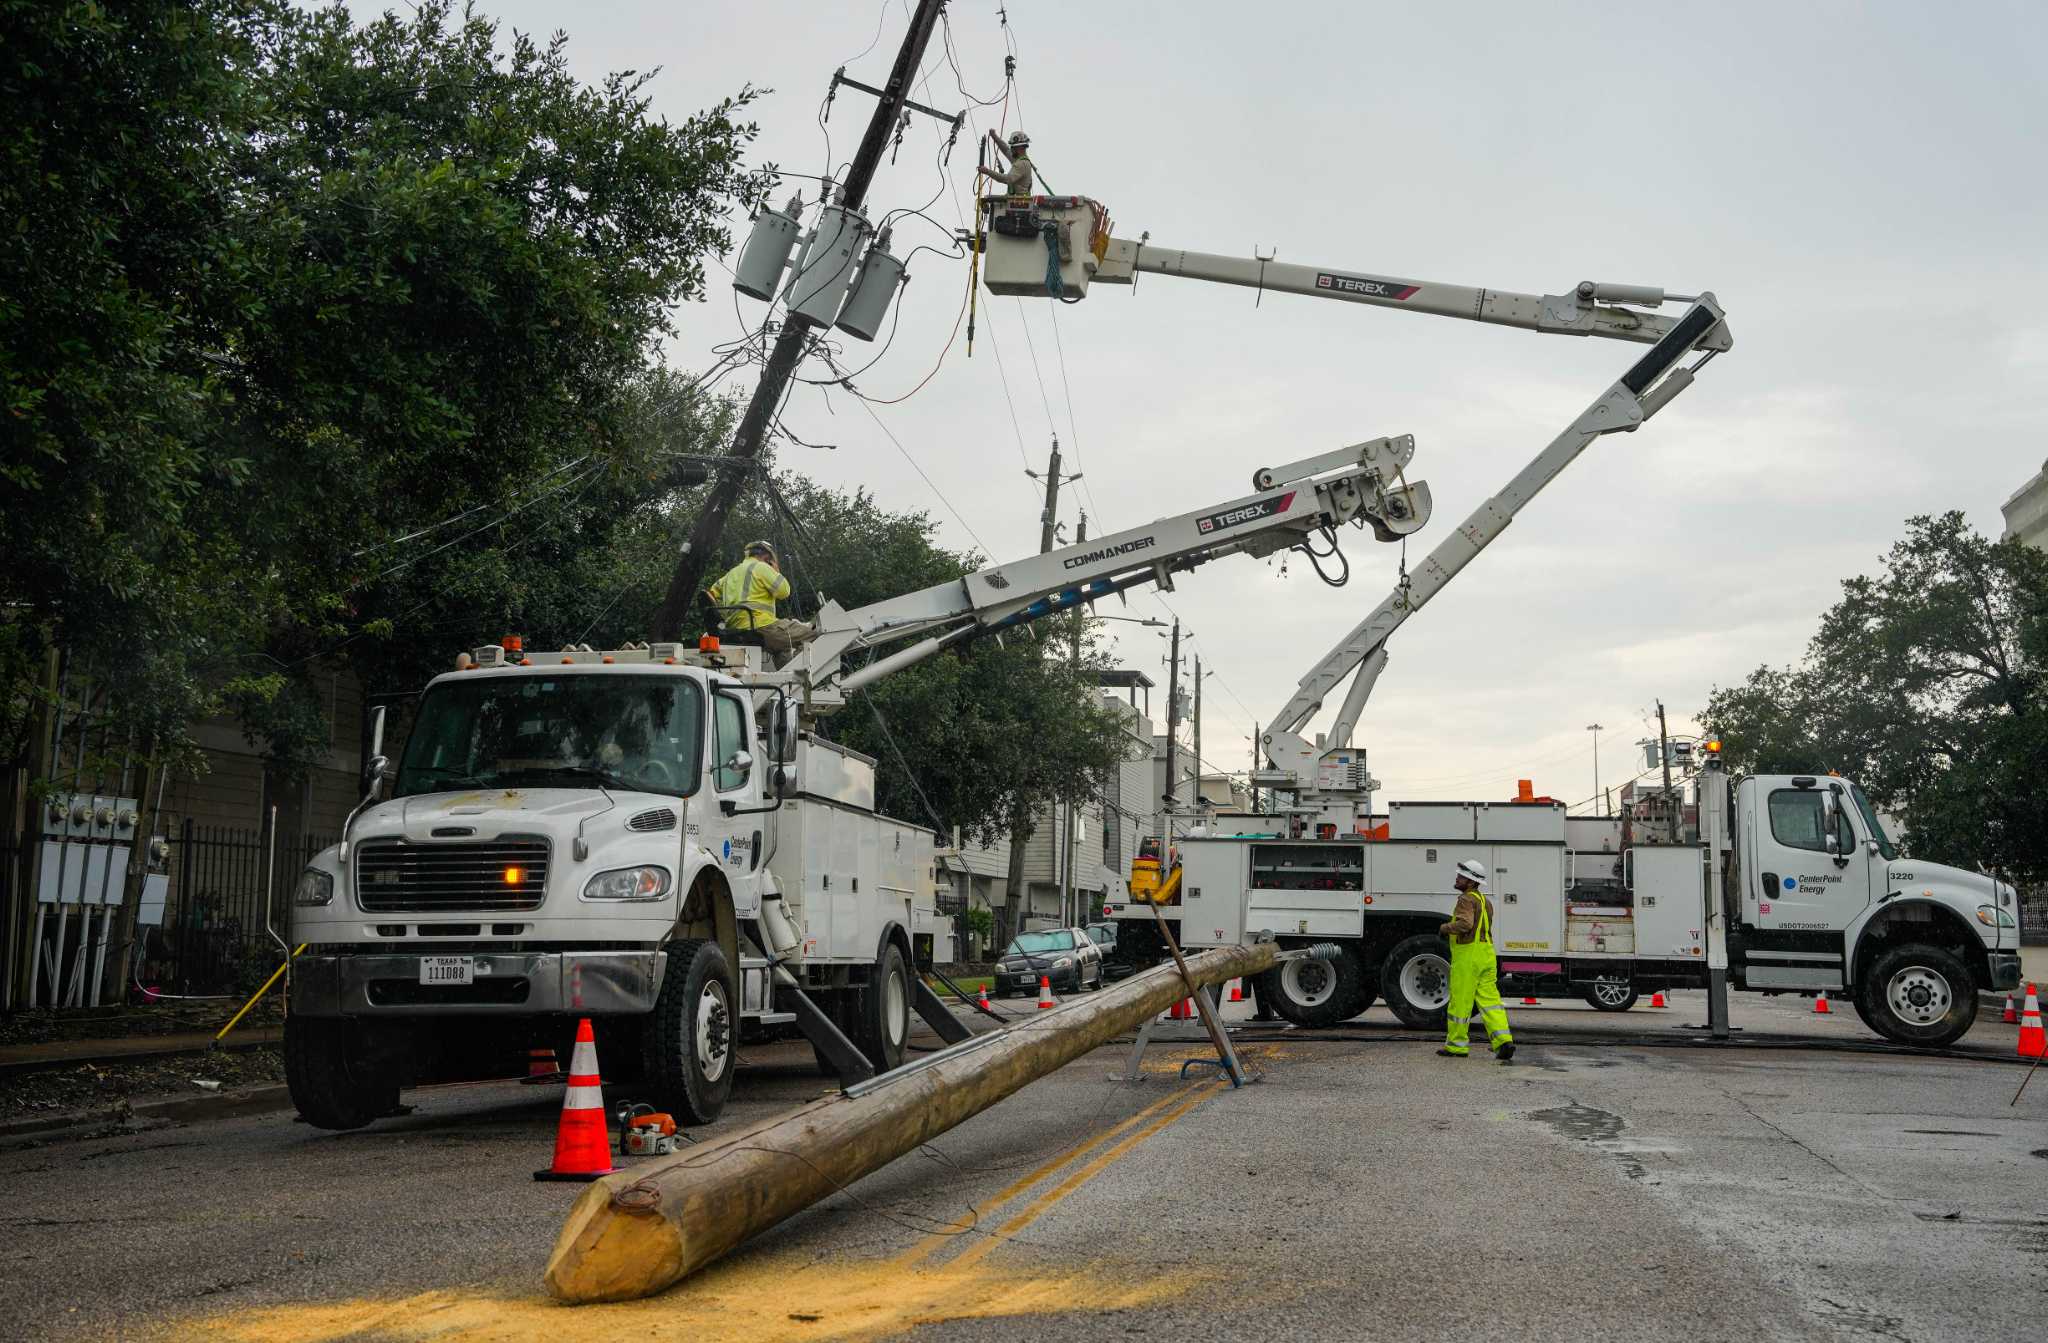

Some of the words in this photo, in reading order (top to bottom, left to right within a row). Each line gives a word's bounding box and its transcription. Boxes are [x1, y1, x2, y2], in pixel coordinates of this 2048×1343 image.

[1335, 278, 1384, 295] TEREX
[1216, 503, 1266, 527] TEREX
[1063, 535, 1156, 570] COMMANDER
[1798, 874, 1842, 884] CenterPoint
[1890, 872, 1914, 881] 3220
[1799, 884, 1826, 895] Energy
[436, 958, 457, 966] TEXAS
